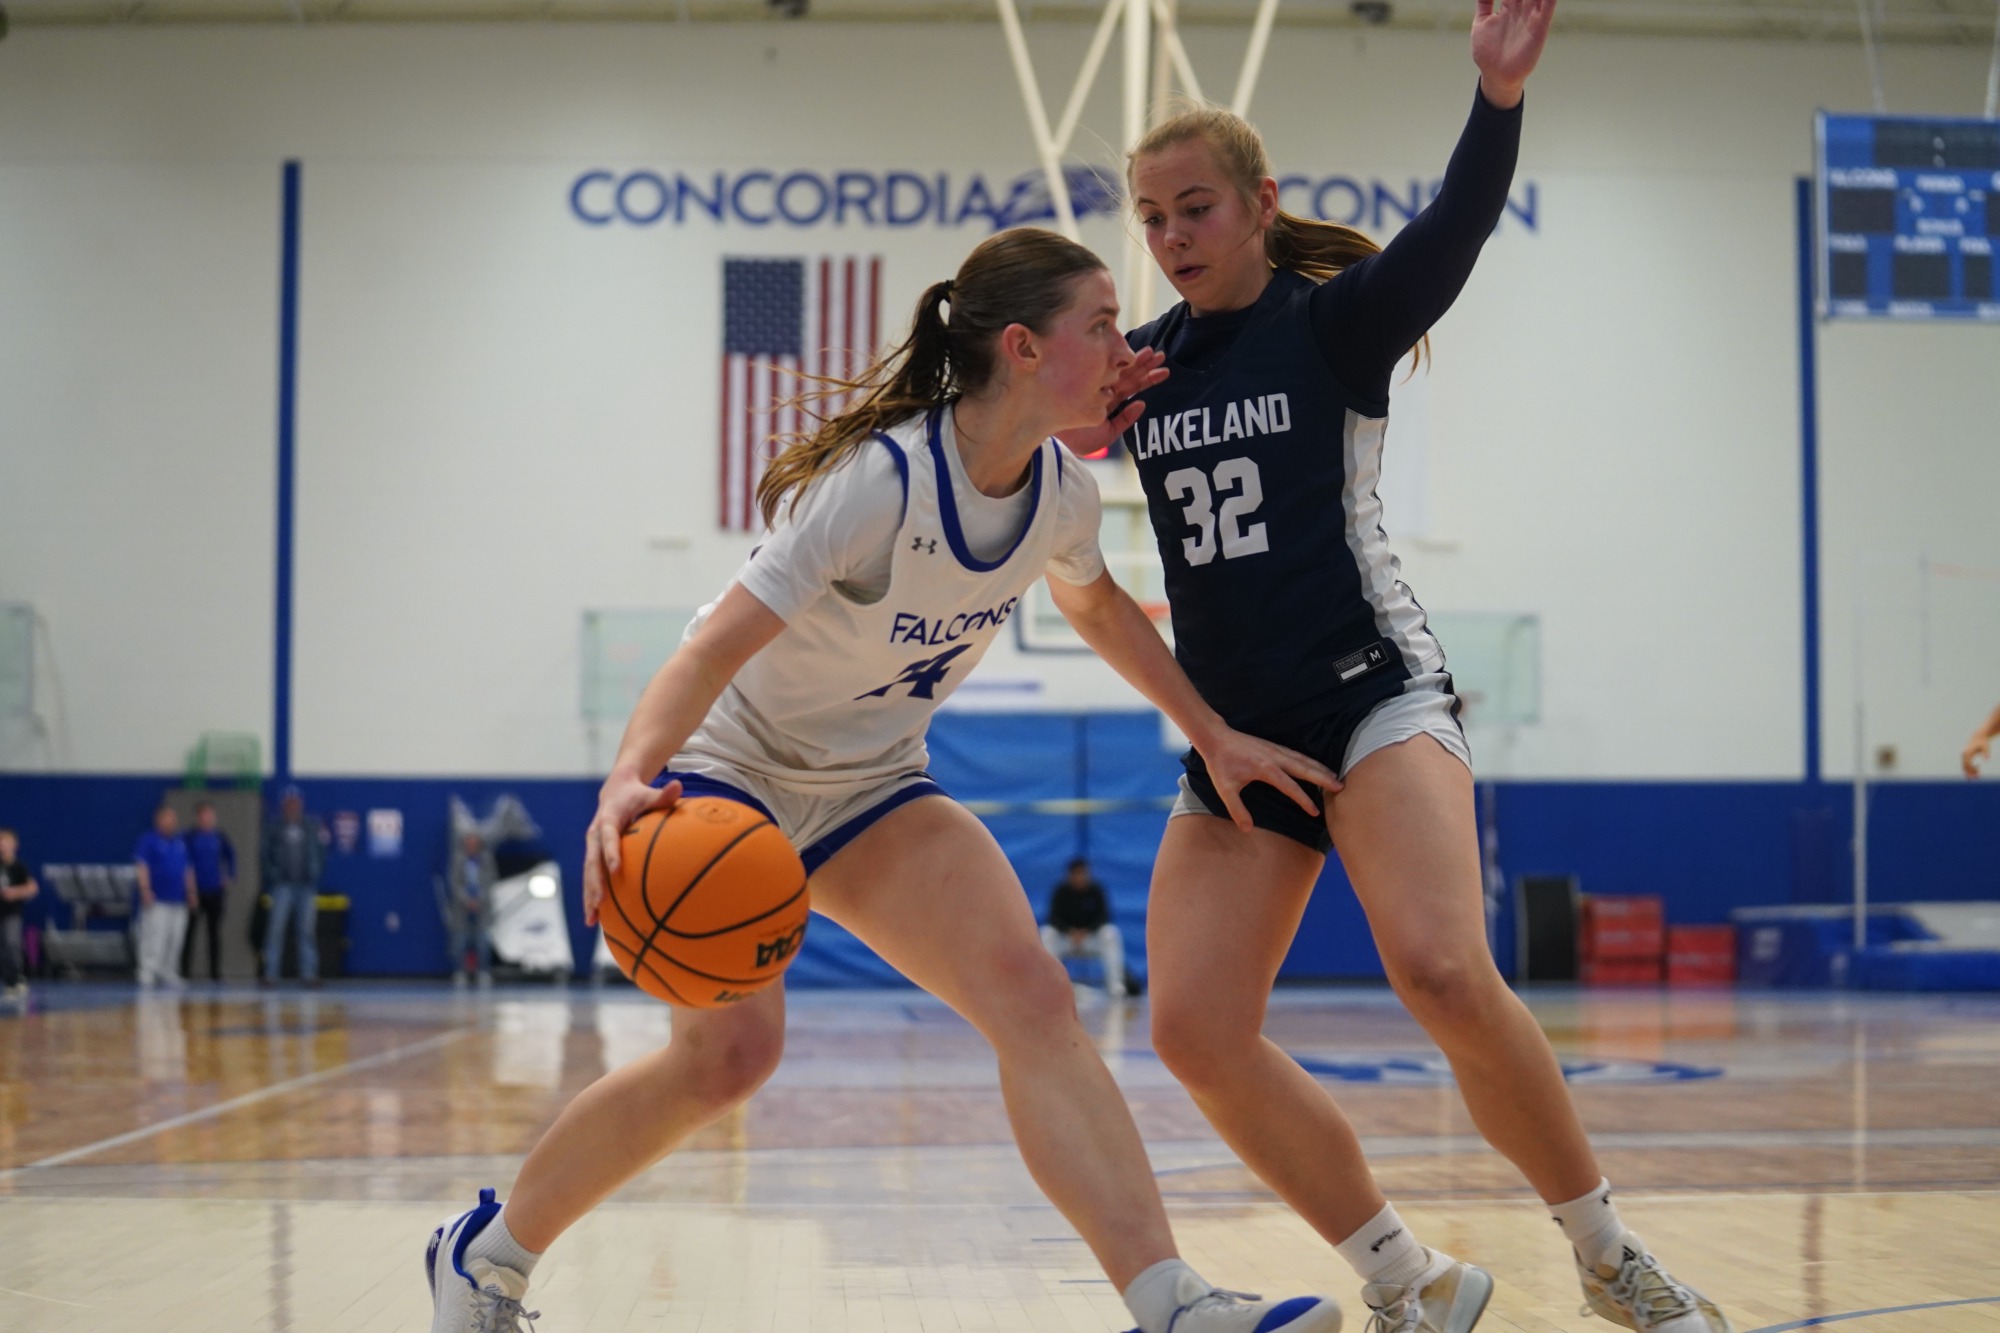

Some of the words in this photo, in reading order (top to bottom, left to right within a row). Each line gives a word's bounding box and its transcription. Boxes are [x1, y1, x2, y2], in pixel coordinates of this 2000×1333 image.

[569, 169, 995, 226] CONCORDIA
[1134, 393, 1291, 460] LAKELAND
[1164, 457, 1269, 567] 32
[1369, 650, 1381, 661] M
